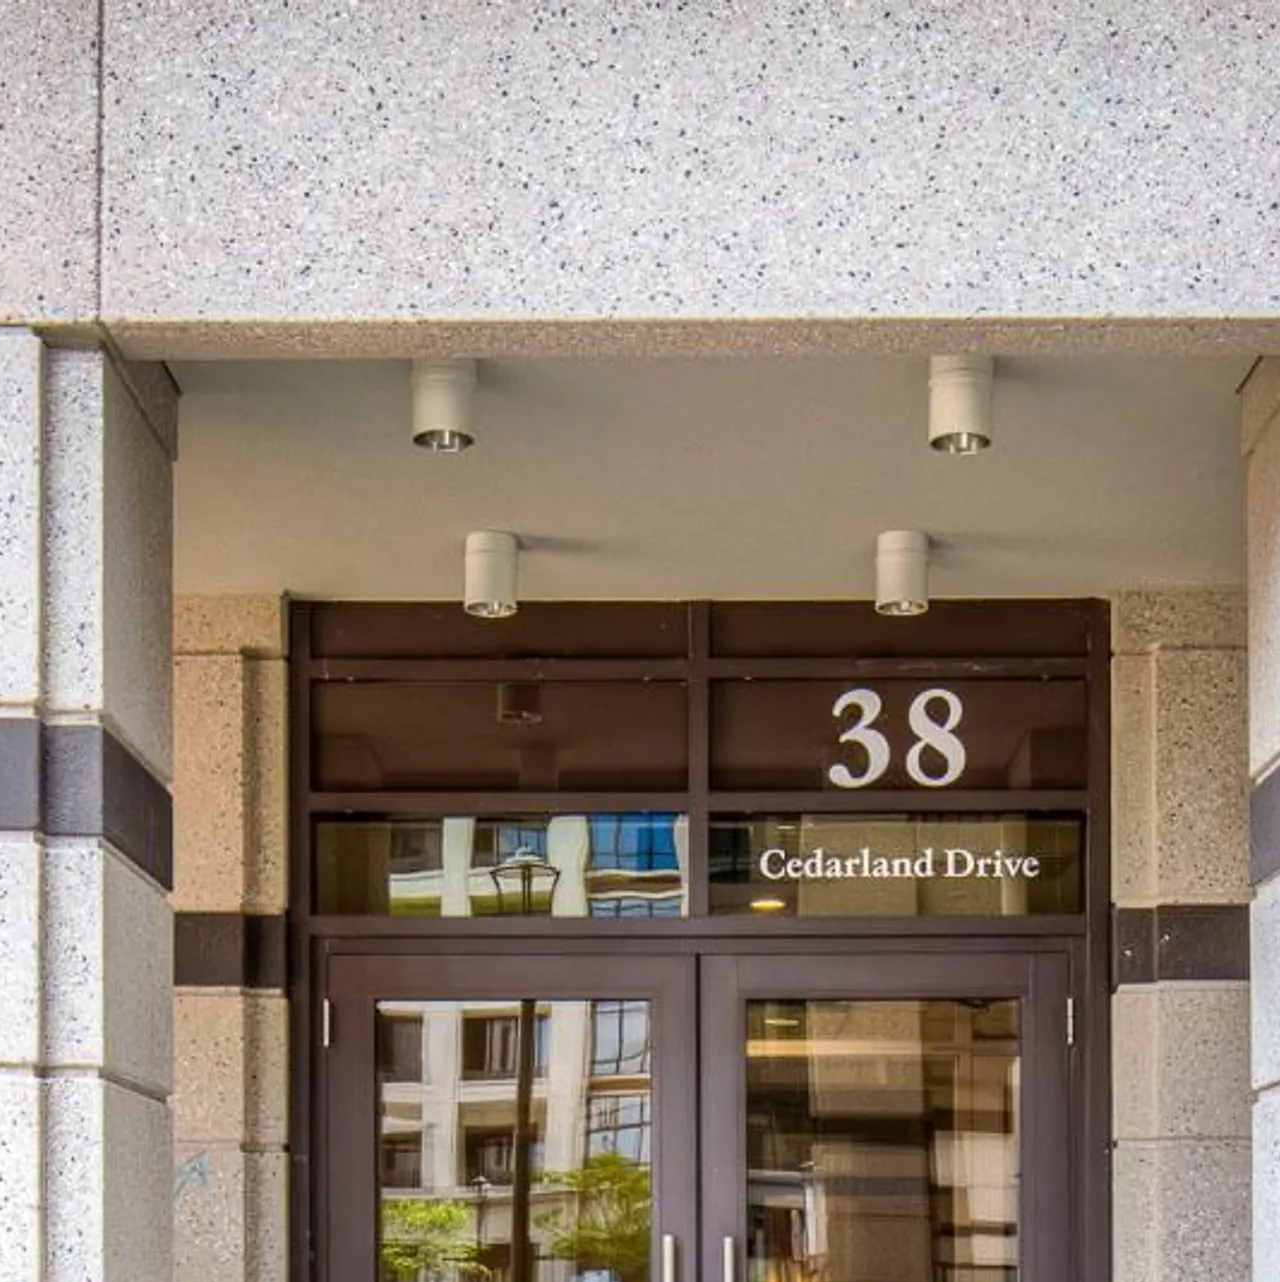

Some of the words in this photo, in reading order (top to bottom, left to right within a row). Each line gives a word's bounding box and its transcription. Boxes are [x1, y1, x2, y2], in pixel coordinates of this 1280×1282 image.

[828, 687, 967, 789] 38
[759, 847, 935, 879] Cedarland
[943, 848, 1040, 878] Drive
